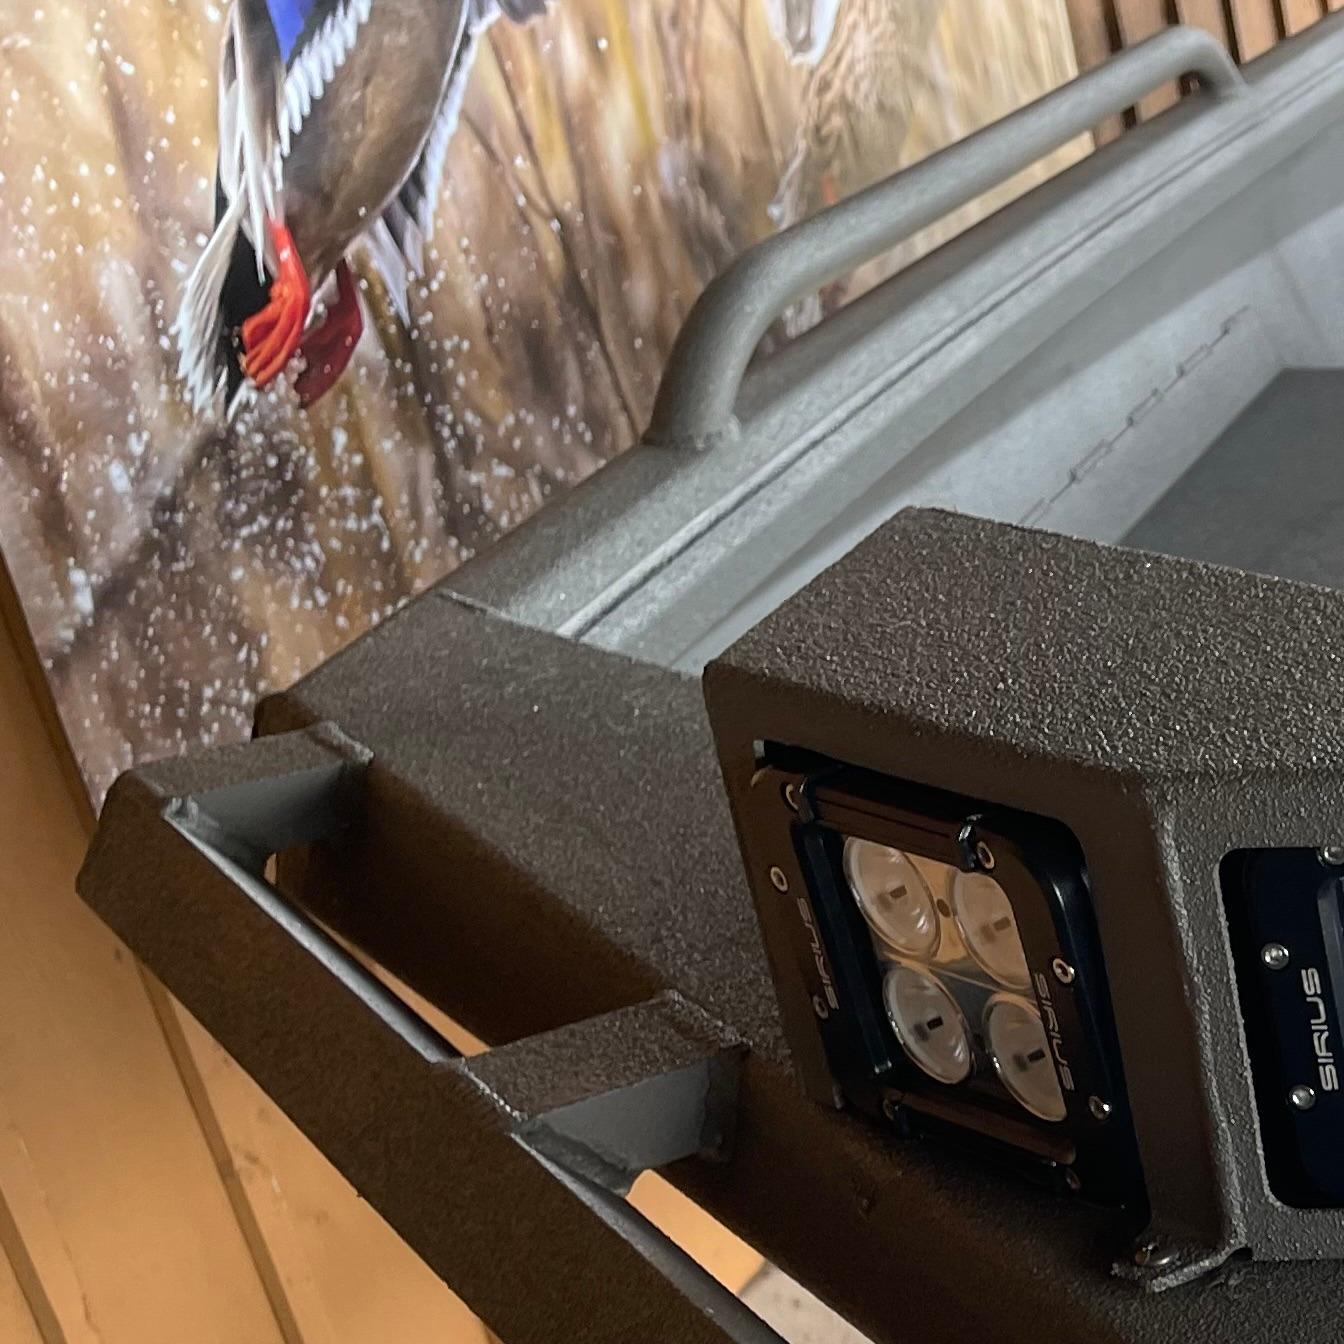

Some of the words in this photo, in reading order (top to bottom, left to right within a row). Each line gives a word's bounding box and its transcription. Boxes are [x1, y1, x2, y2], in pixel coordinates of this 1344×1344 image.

[797, 897, 839, 1010] SIRIUS
[1034, 973, 1075, 1090] SIRIUS
[1301, 967, 1339, 1091] SIRIUS
